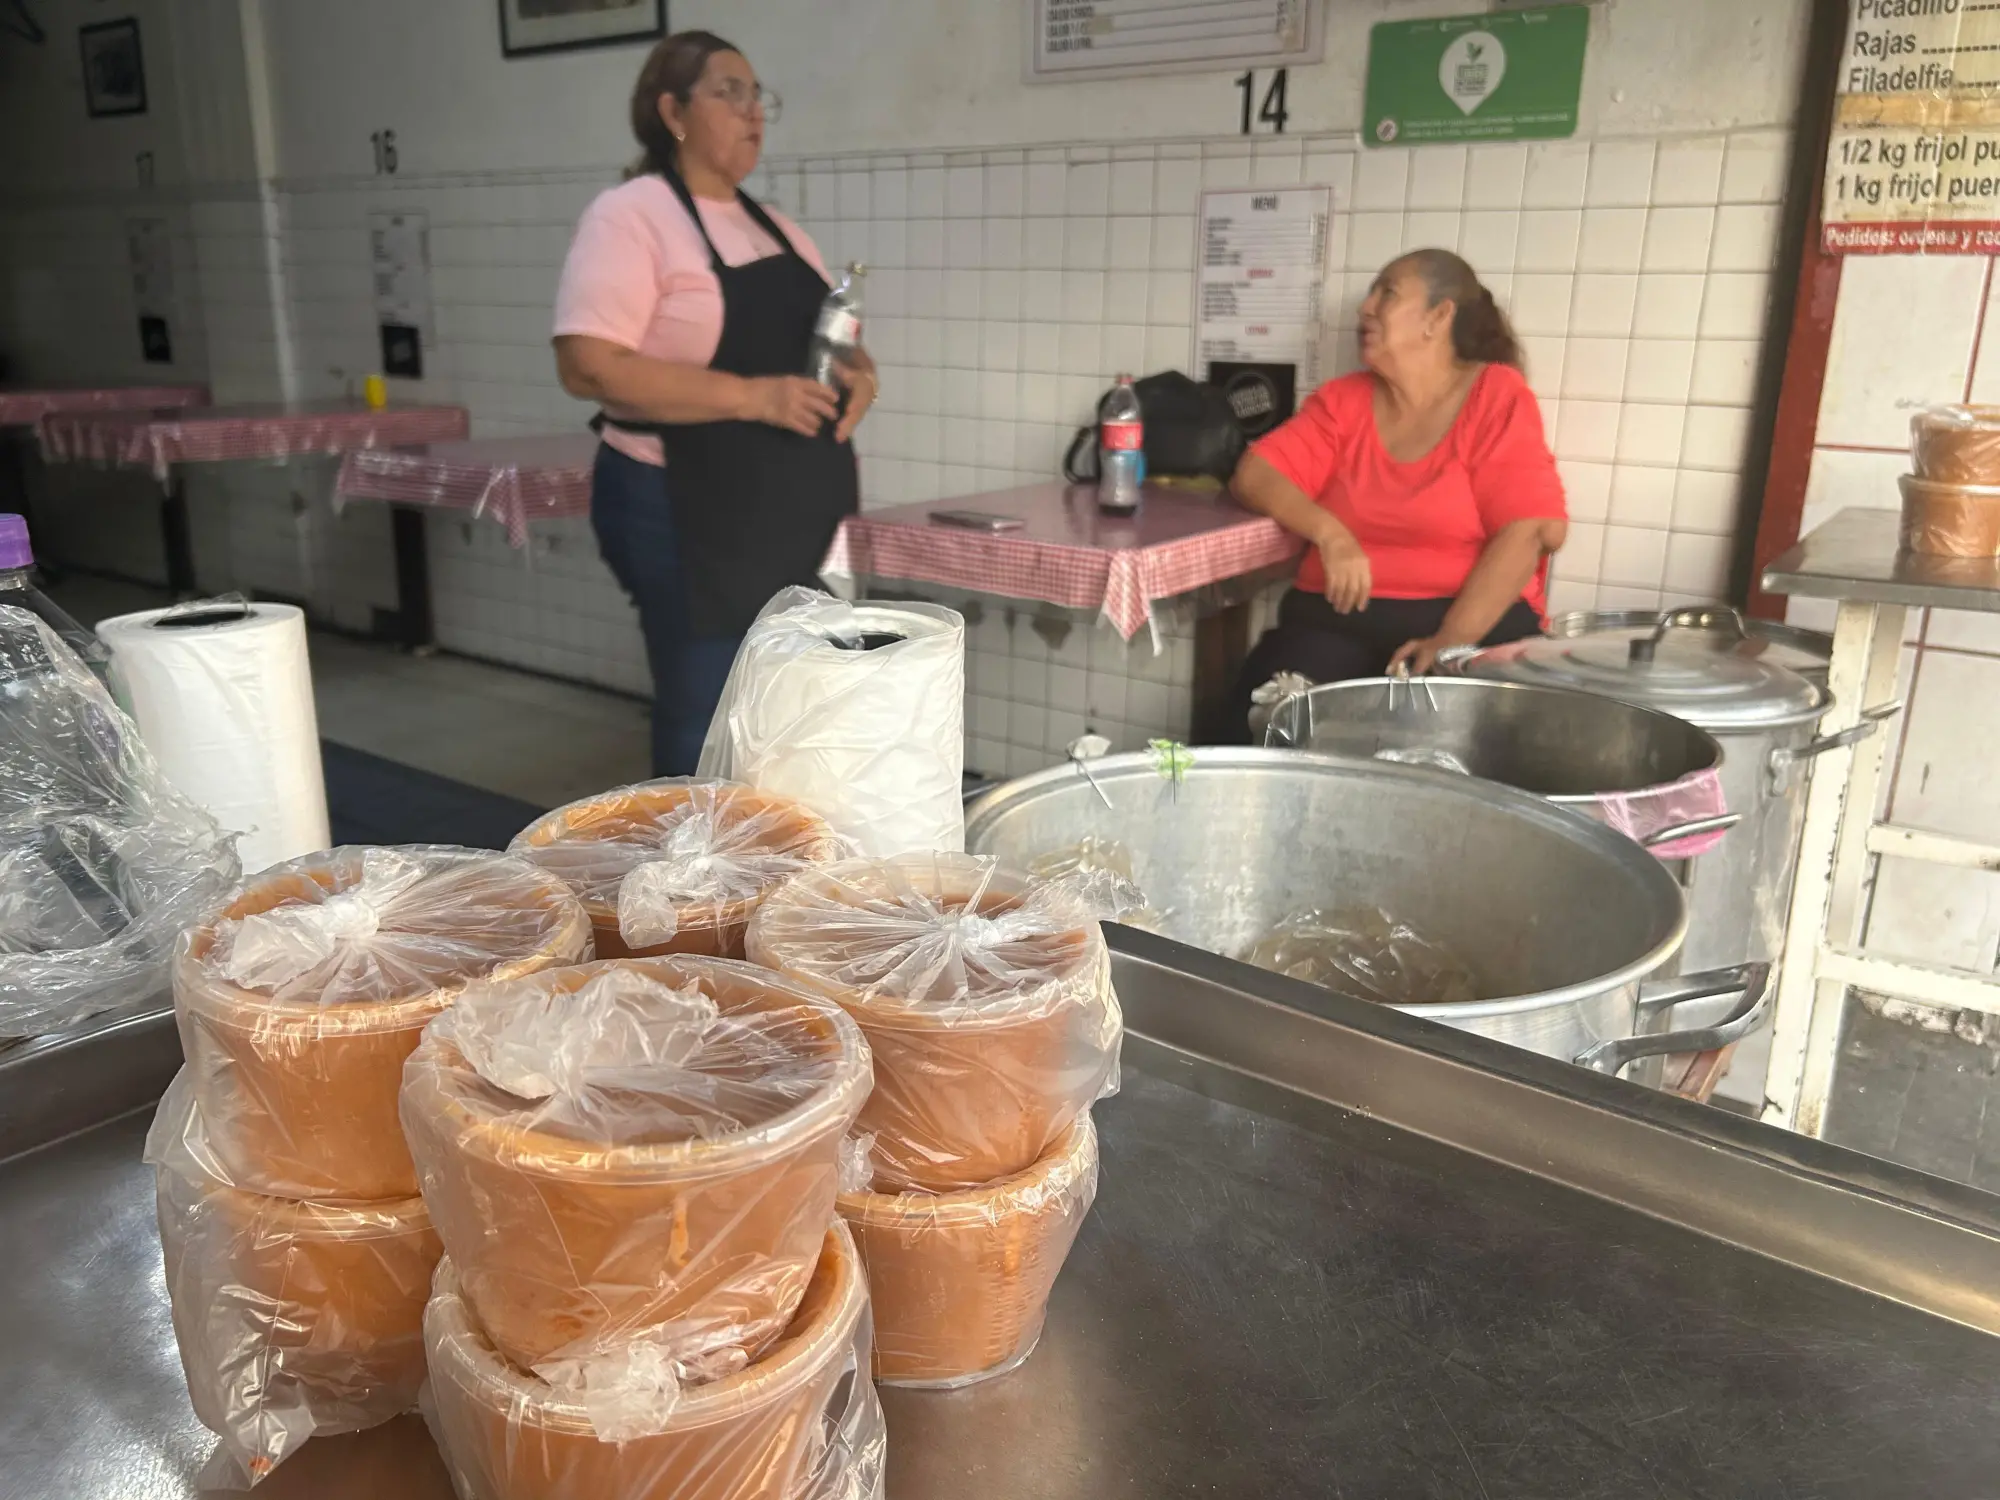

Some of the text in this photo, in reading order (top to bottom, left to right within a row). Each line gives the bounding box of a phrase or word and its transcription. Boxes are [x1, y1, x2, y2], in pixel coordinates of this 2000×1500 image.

[1857, 0, 1959, 20] Picadillo
[1853, 29, 1917, 61] Rajas
[1848, 62, 1954, 93] Filadelfia
[1235, 68, 1288, 135] 14
[1840, 138, 1872, 165] 1/2
[1878, 138, 1907, 168] kg
[1914, 135, 1968, 168] frijol
[1837, 174, 1846, 200] 1
[1853, 174, 1881, 205] kg
[1889, 172, 1942, 204] frijol
[1960, 229, 1973, 250] y
